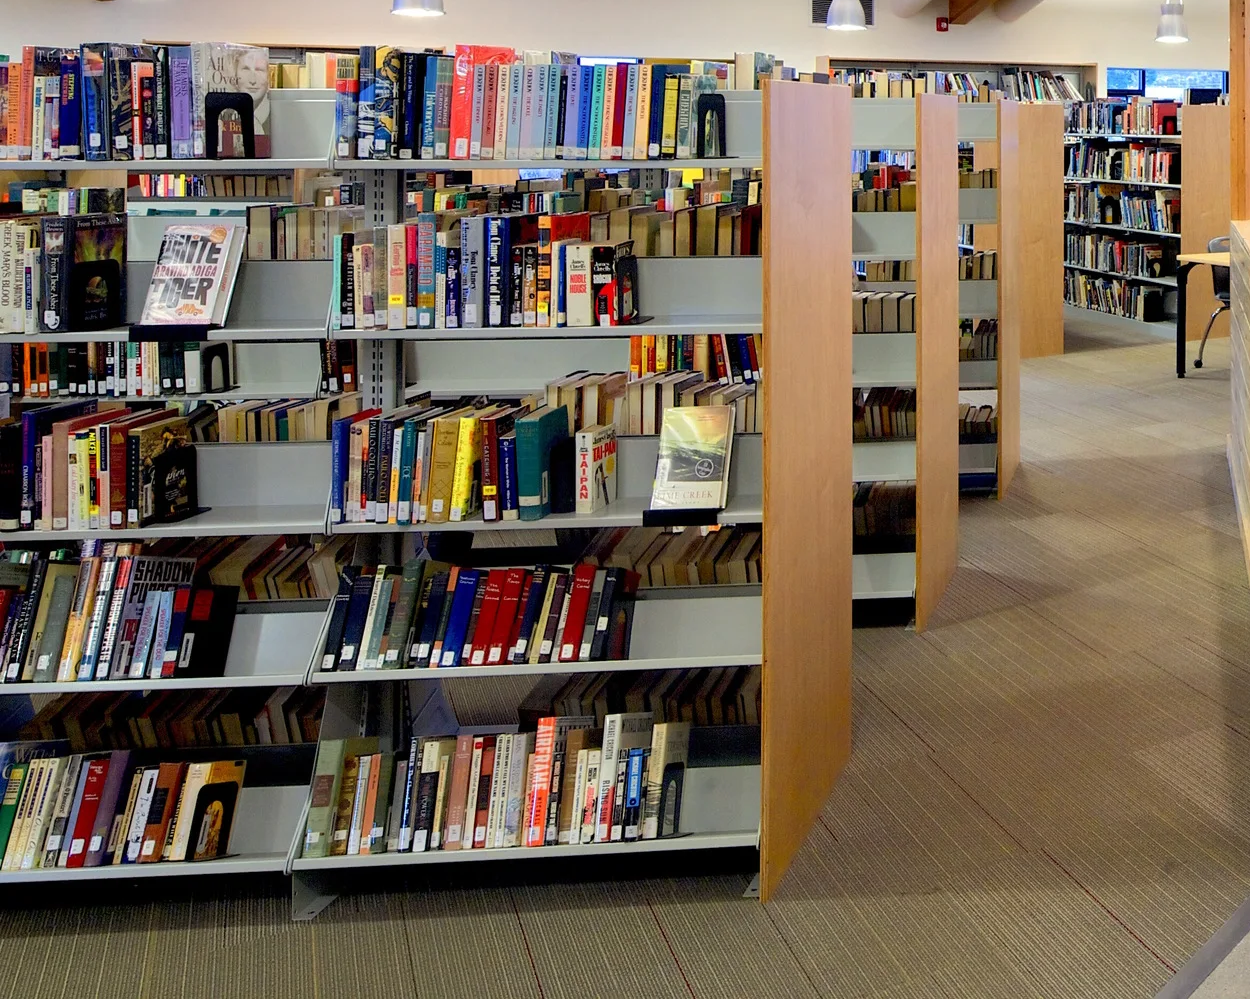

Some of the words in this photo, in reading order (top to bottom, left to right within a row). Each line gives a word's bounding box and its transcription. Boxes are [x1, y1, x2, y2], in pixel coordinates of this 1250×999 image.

[206, 56, 224, 71] All
[212, 70, 242, 85] Over
[76, 220, 91, 228] From
[92, 219, 106, 227] These
[490, 219, 500, 235] Tom
[157, 234, 222, 265] WHITE
[418, 222, 433, 285] CARAMELO
[490, 237, 501, 263] Clancy
[1, 250, 11, 277] MARY'S
[50, 257, 59, 273] From
[153, 265, 189, 278] ARAVIND
[190, 265, 218, 277] ADIGA
[50, 275, 59, 291] These
[469, 266, 478, 290] Clancy
[490, 266, 500, 285] Debt
[570, 273, 587, 284] NOBLE
[1, 280, 9, 306] BLOOD
[150, 277, 214, 309] TIGER
[569, 283, 587, 294] HOUSE
[50, 294, 58, 310] Ashes
[593, 441, 616, 463] TAI-PAN
[380, 455, 388, 479] PAULO
[403, 465, 411, 479] FOE
[682, 490, 713, 499] CREEK
[134, 560, 195, 583] SHADOW
[16, 601, 28, 629] ETHAN
[141, 606, 152, 626] SPEAKER
[140, 627, 148, 636] FOR
[12, 632, 22, 658] CANIN
[607, 720, 615, 738] MICHAEL
[532, 724, 554, 791] AIRFRAME
[605, 739, 613, 760] CRICHTON
[601, 780, 610, 805] RISING
